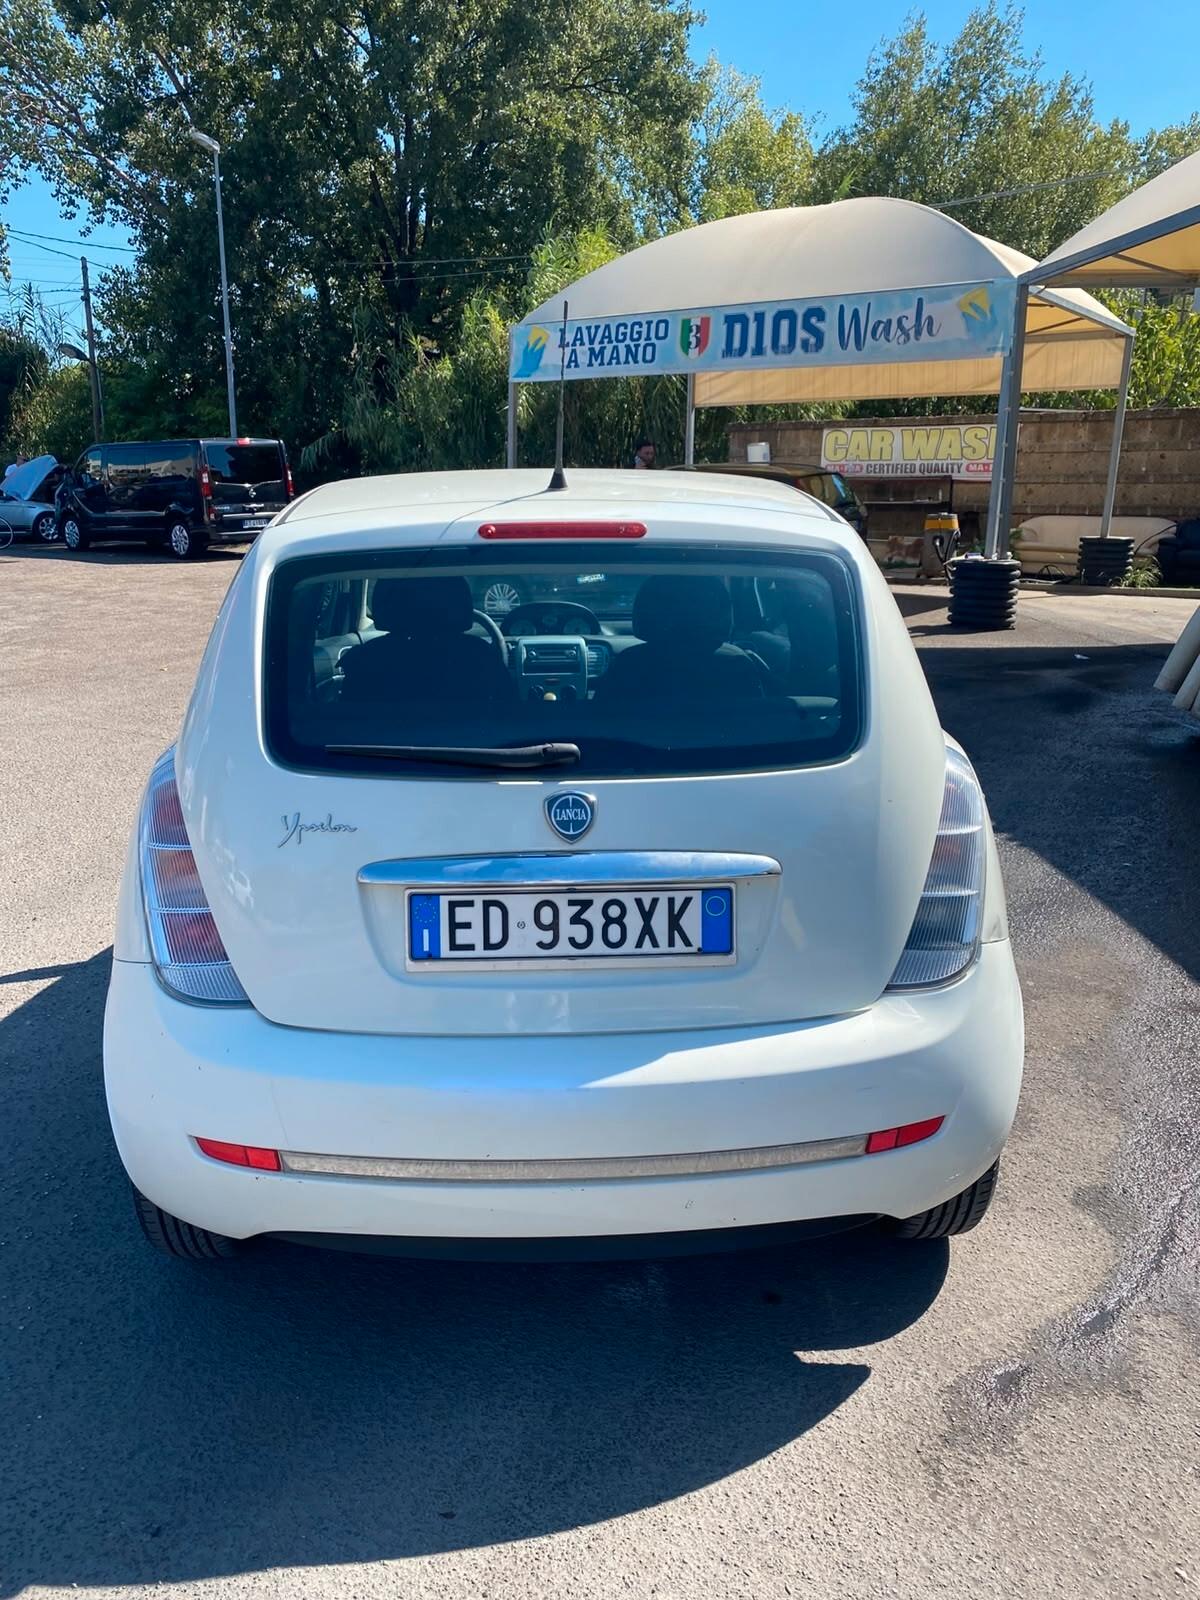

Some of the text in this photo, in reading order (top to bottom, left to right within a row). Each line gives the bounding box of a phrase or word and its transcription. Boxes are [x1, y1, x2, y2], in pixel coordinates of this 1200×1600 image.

[558, 318, 670, 348] LAVAGGIO
[837, 297, 941, 352] Wash
[565, 342, 657, 369] A MANO
[824, 428, 895, 462] CAR
[866, 463, 917, 475] CERTIFIED
[918, 462, 963, 475] QUALITY
[277, 812, 358, 848] Ypsilon
[555, 808, 587, 821] LANCIA
[447, 899, 510, 952] ED
[533, 896, 694, 950] 938XK
